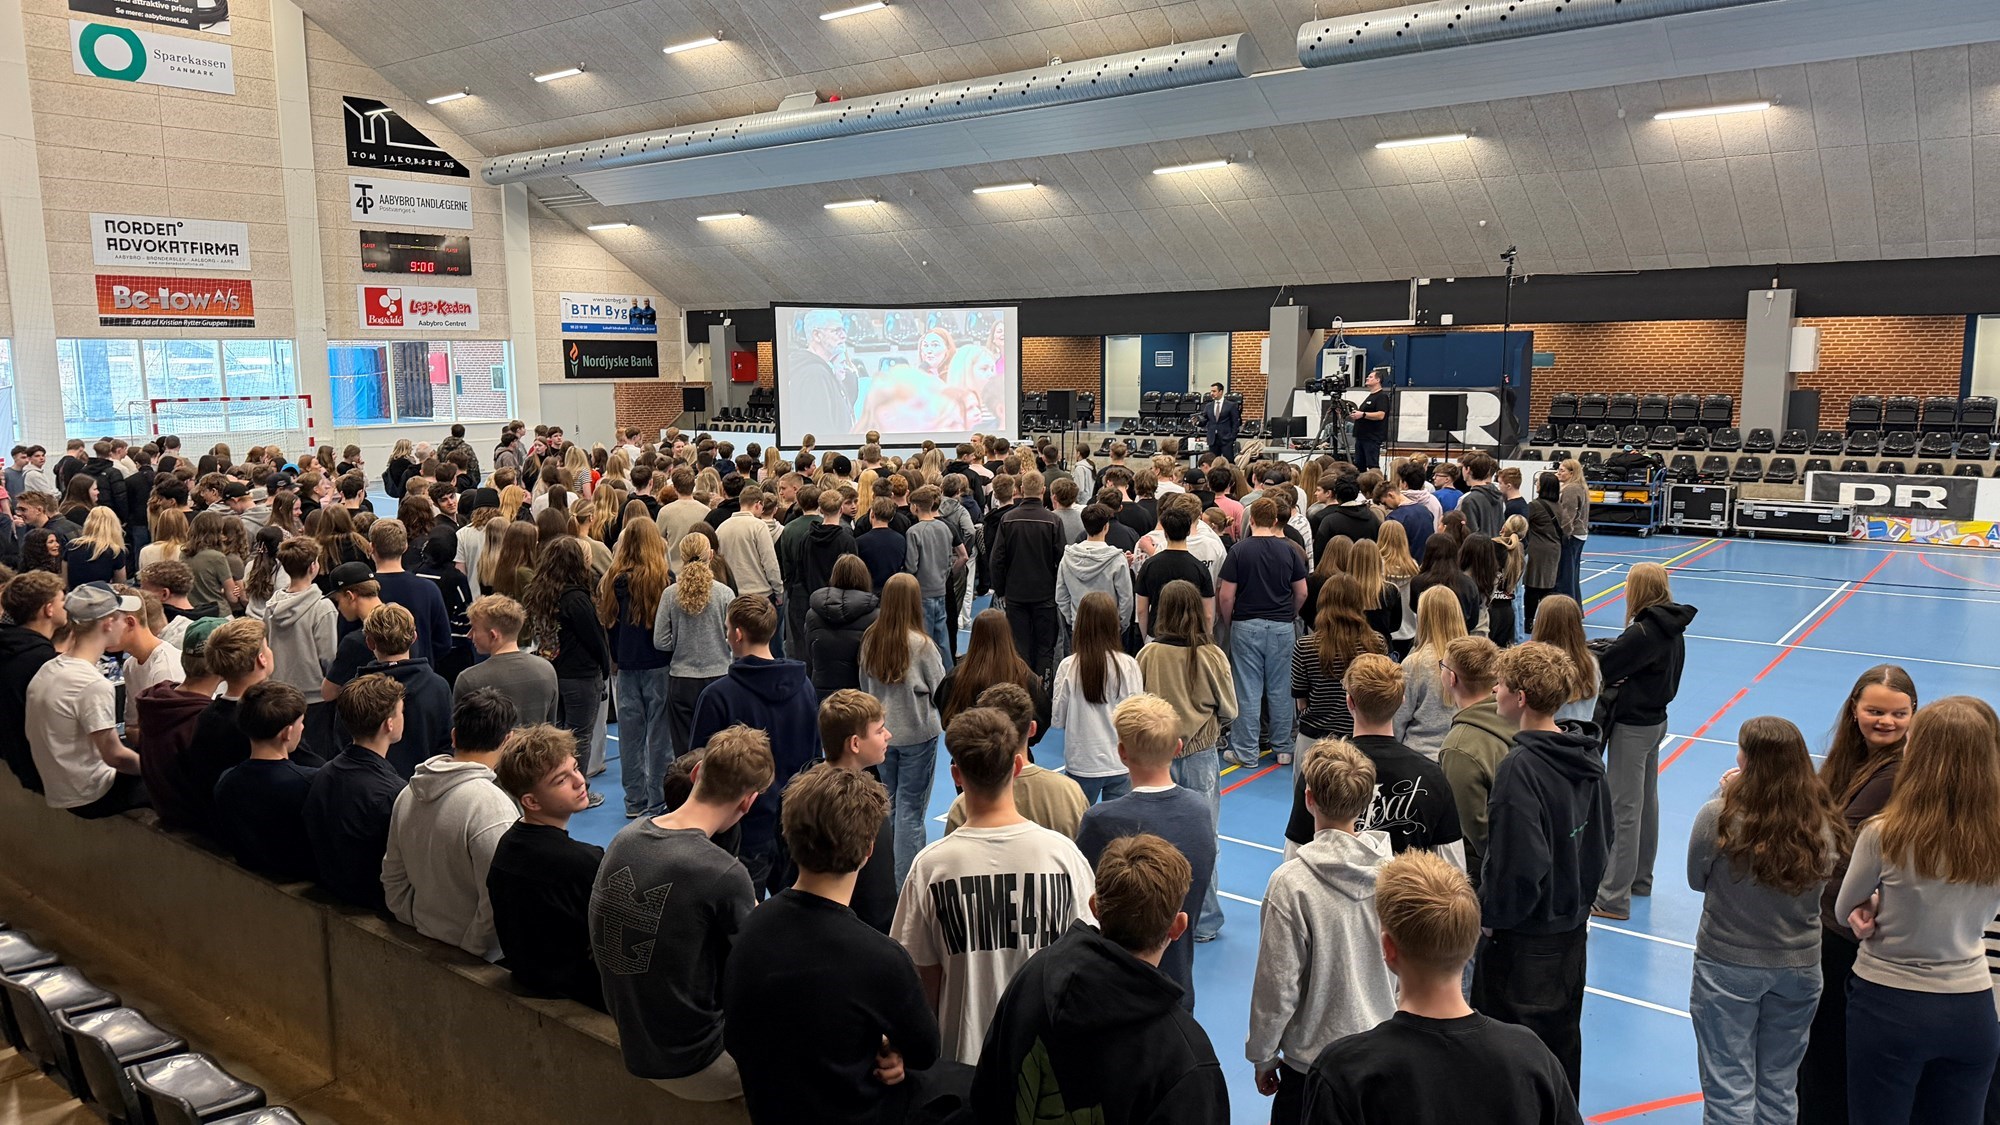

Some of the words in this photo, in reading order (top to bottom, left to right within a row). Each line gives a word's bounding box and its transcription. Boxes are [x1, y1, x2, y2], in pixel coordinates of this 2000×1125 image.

[132, 0, 170, 10] attraktive
[171, 5, 194, 14] priser
[144, 12, 189, 25] aabybronet.dk
[153, 48, 227, 70] Sparekassen
[170, 65, 214, 77] DANMARK
[352, 151, 376, 160] TOM
[383, 154, 441, 167] JAKOBSEN
[443, 161, 455, 169] A/S
[379, 194, 415, 207] AABYBRO
[416, 197, 468, 212] TANDLÆGERNE
[379, 205, 411, 214] Postvænget
[106, 237, 240, 257] ADVOKATFIRMA
[410, 261, 435, 273] 9:00
[592, 297, 628, 305] www.btmbyg.dk
[571, 303, 600, 316] BTM
[605, 305, 628, 320] Byg
[183, 319, 201, 327] Rytter
[201, 319, 227, 328] Gruppen
[368, 314, 403, 326] Bog&idé
[418, 320, 444, 328] Aabybro
[582, 355, 629, 371] Nordjyske
[630, 355, 653, 367] Bank
[1838, 482, 1948, 510] DR
